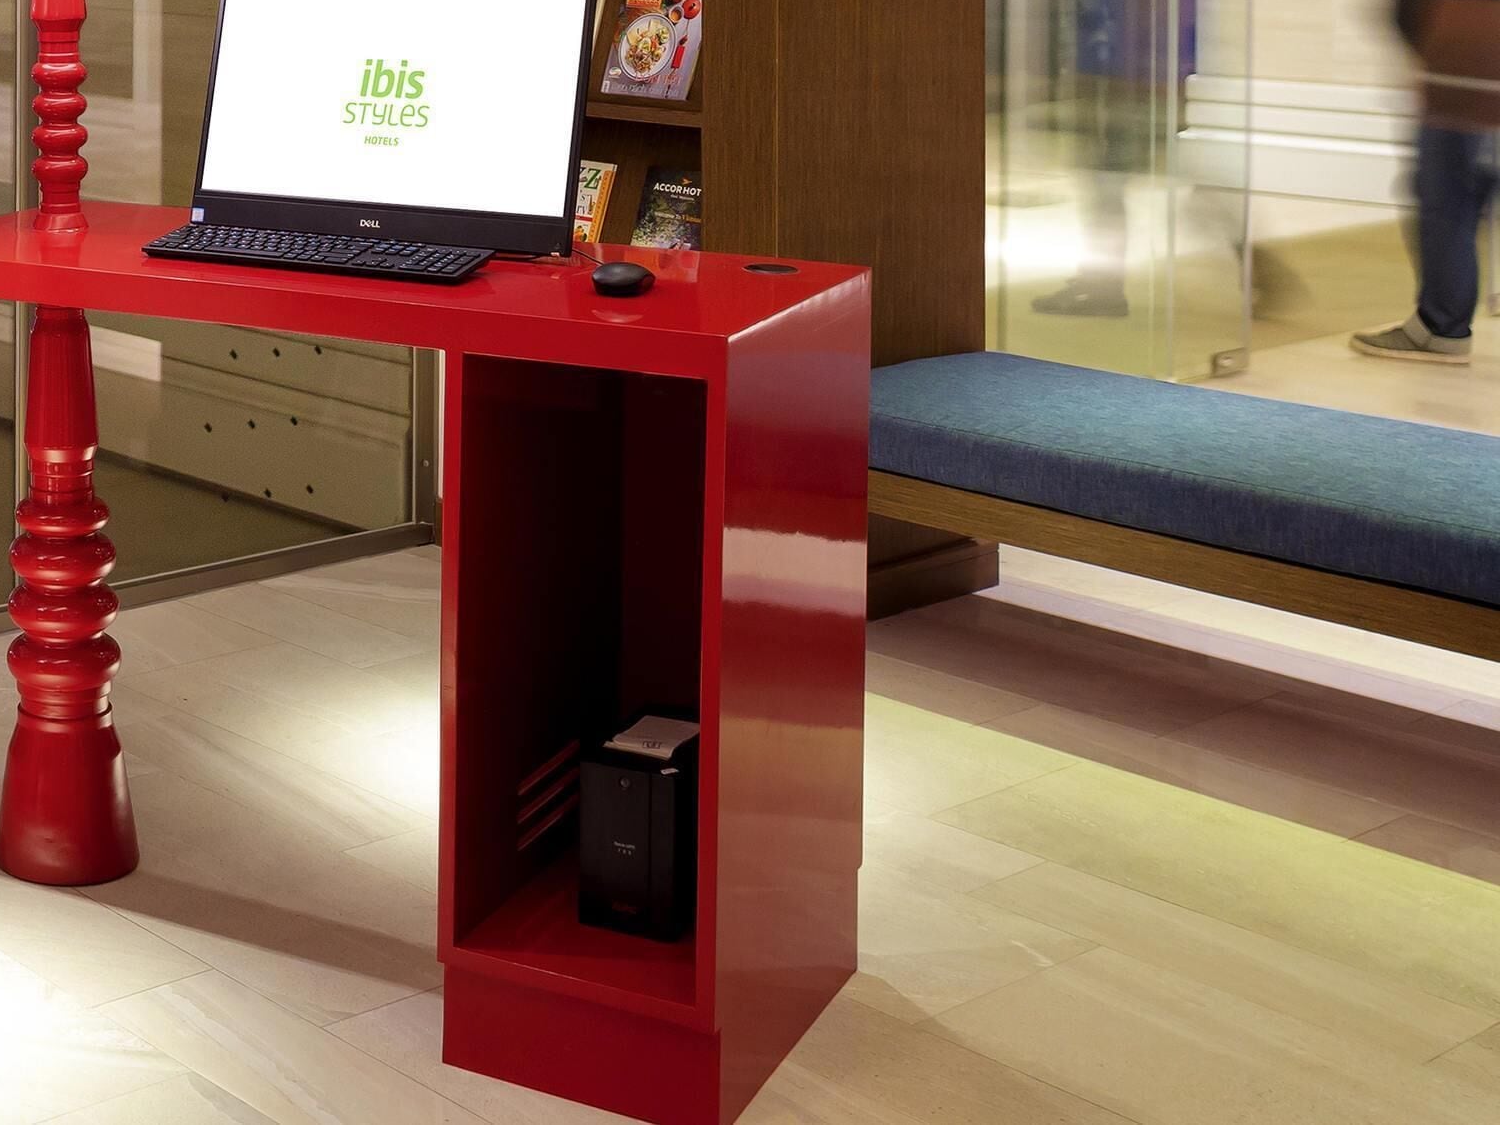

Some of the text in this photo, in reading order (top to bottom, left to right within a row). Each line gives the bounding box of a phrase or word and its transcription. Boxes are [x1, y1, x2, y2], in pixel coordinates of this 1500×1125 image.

[360, 59, 425, 99] ibis
[364, 135, 400, 147] HOTELS
[653, 182, 702, 196] ACCORHOT
[359, 219, 381, 228] DELL
